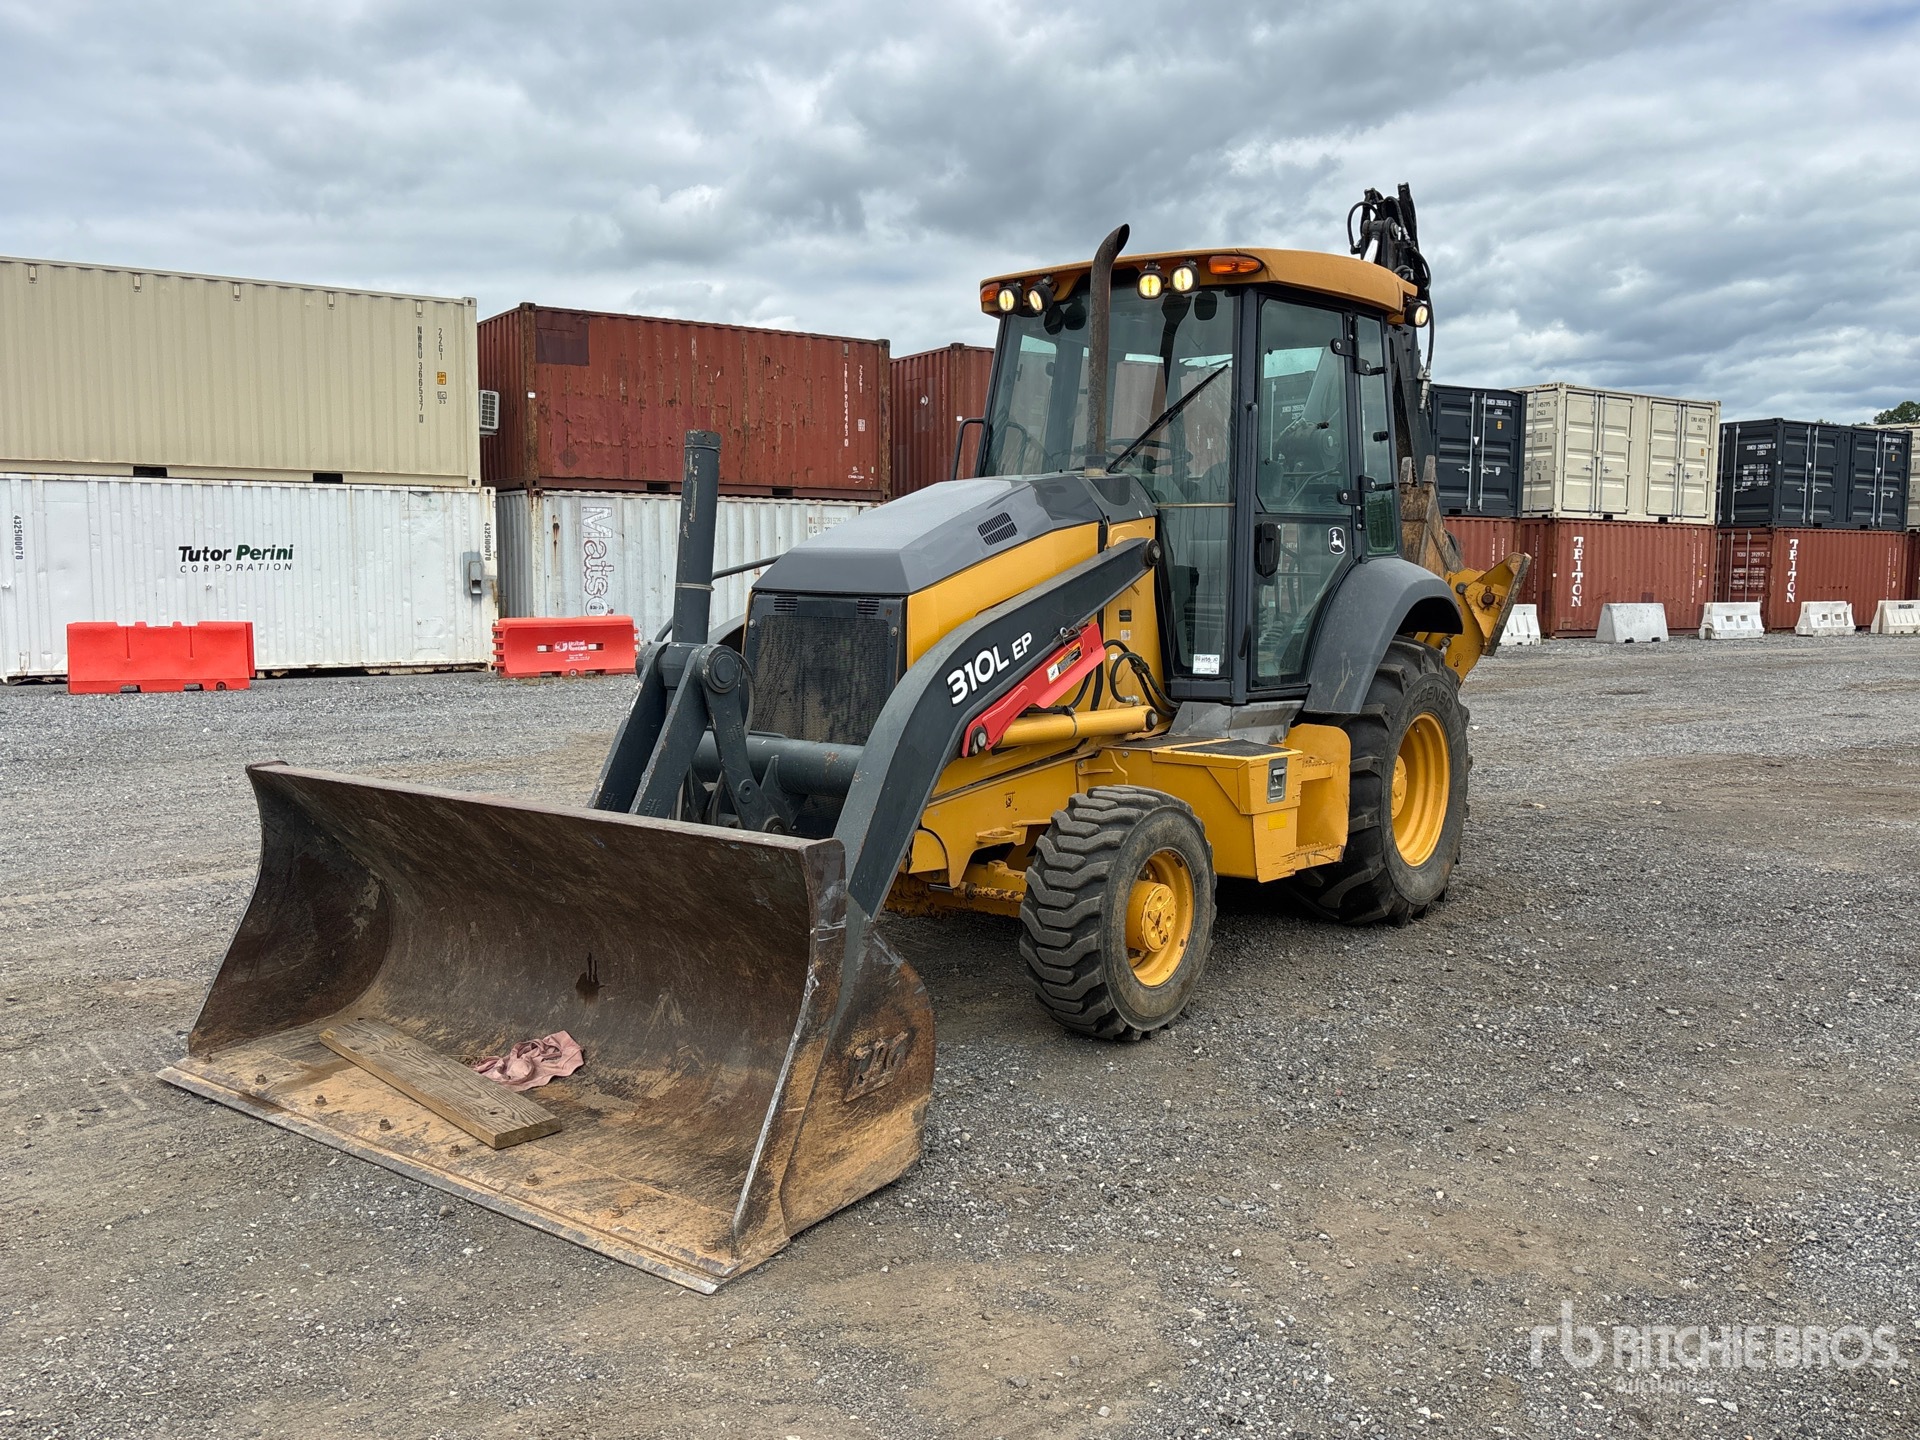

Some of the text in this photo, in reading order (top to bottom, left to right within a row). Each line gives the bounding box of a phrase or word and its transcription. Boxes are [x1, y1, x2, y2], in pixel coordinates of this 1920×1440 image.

[178, 544, 294, 563] Tutor Perini
[179, 562, 293, 574] CORPORATION
[1570, 536, 1584, 607] TRITON
[1785, 538, 1799, 603] TRITON
[946, 645, 1010, 706] 310L
[1011, 632, 1033, 662] EP
